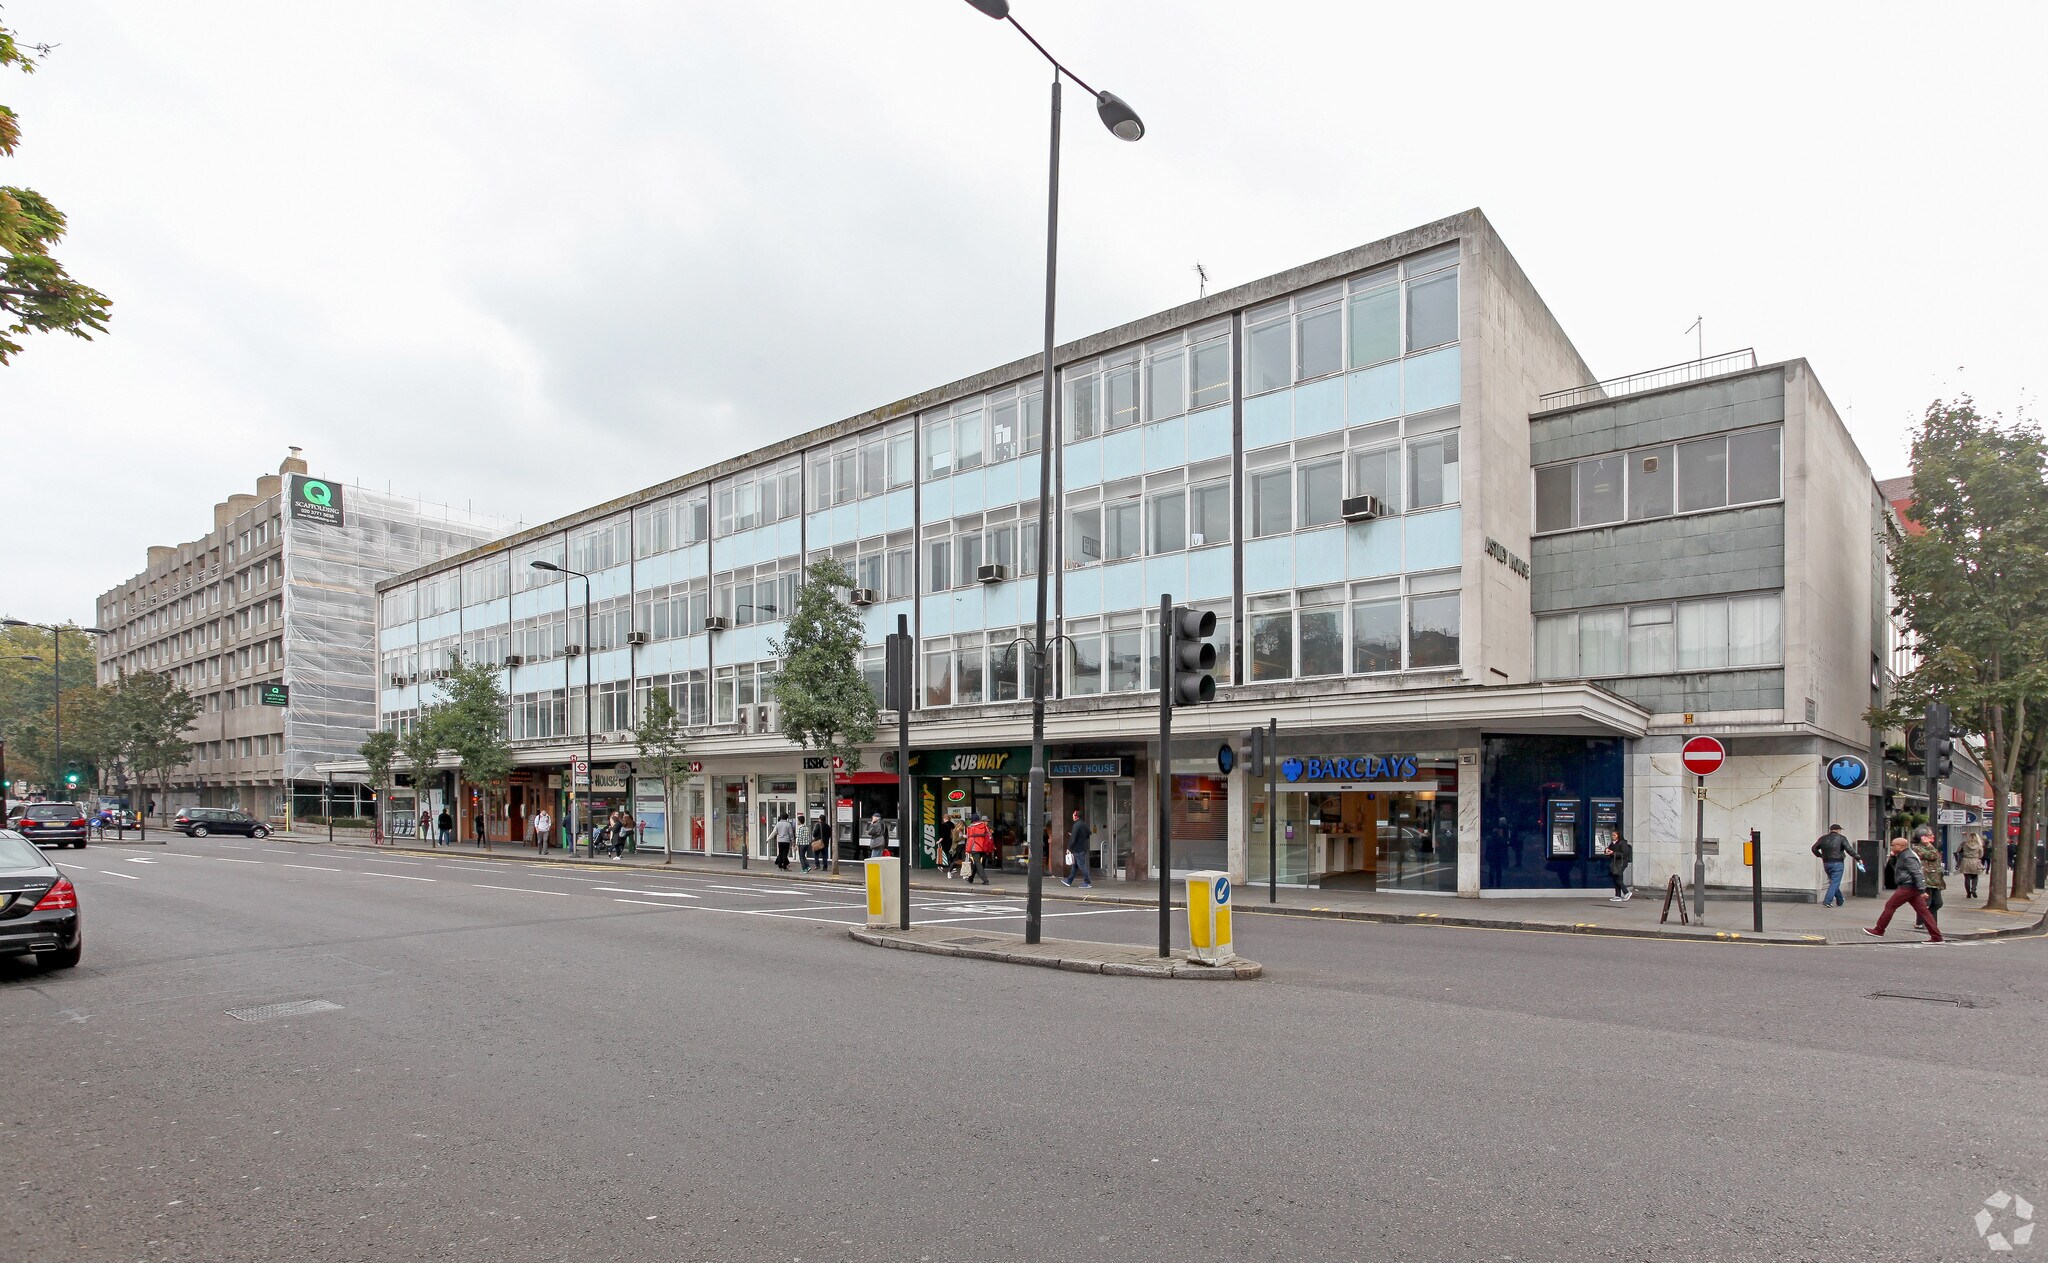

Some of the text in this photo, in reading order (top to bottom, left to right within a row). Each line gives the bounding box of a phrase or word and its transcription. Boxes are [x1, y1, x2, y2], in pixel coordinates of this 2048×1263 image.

[303, 480, 332, 507] Q
[295, 500, 340, 515] SCAFFOLDING
[1484, 536, 1529, 580] ASTLEY HOUSE
[803, 756, 829, 769] HSBC
[951, 752, 1009, 771] SUBWAY
[1053, 763, 1115, 773] ASTLEY HOUSE
[1307, 756, 1418, 780] BARCLAYS
[595, 774, 618, 788] HOUSE
[950, 791, 964, 799] OPEN
[923, 783, 936, 860] SUBWAY
